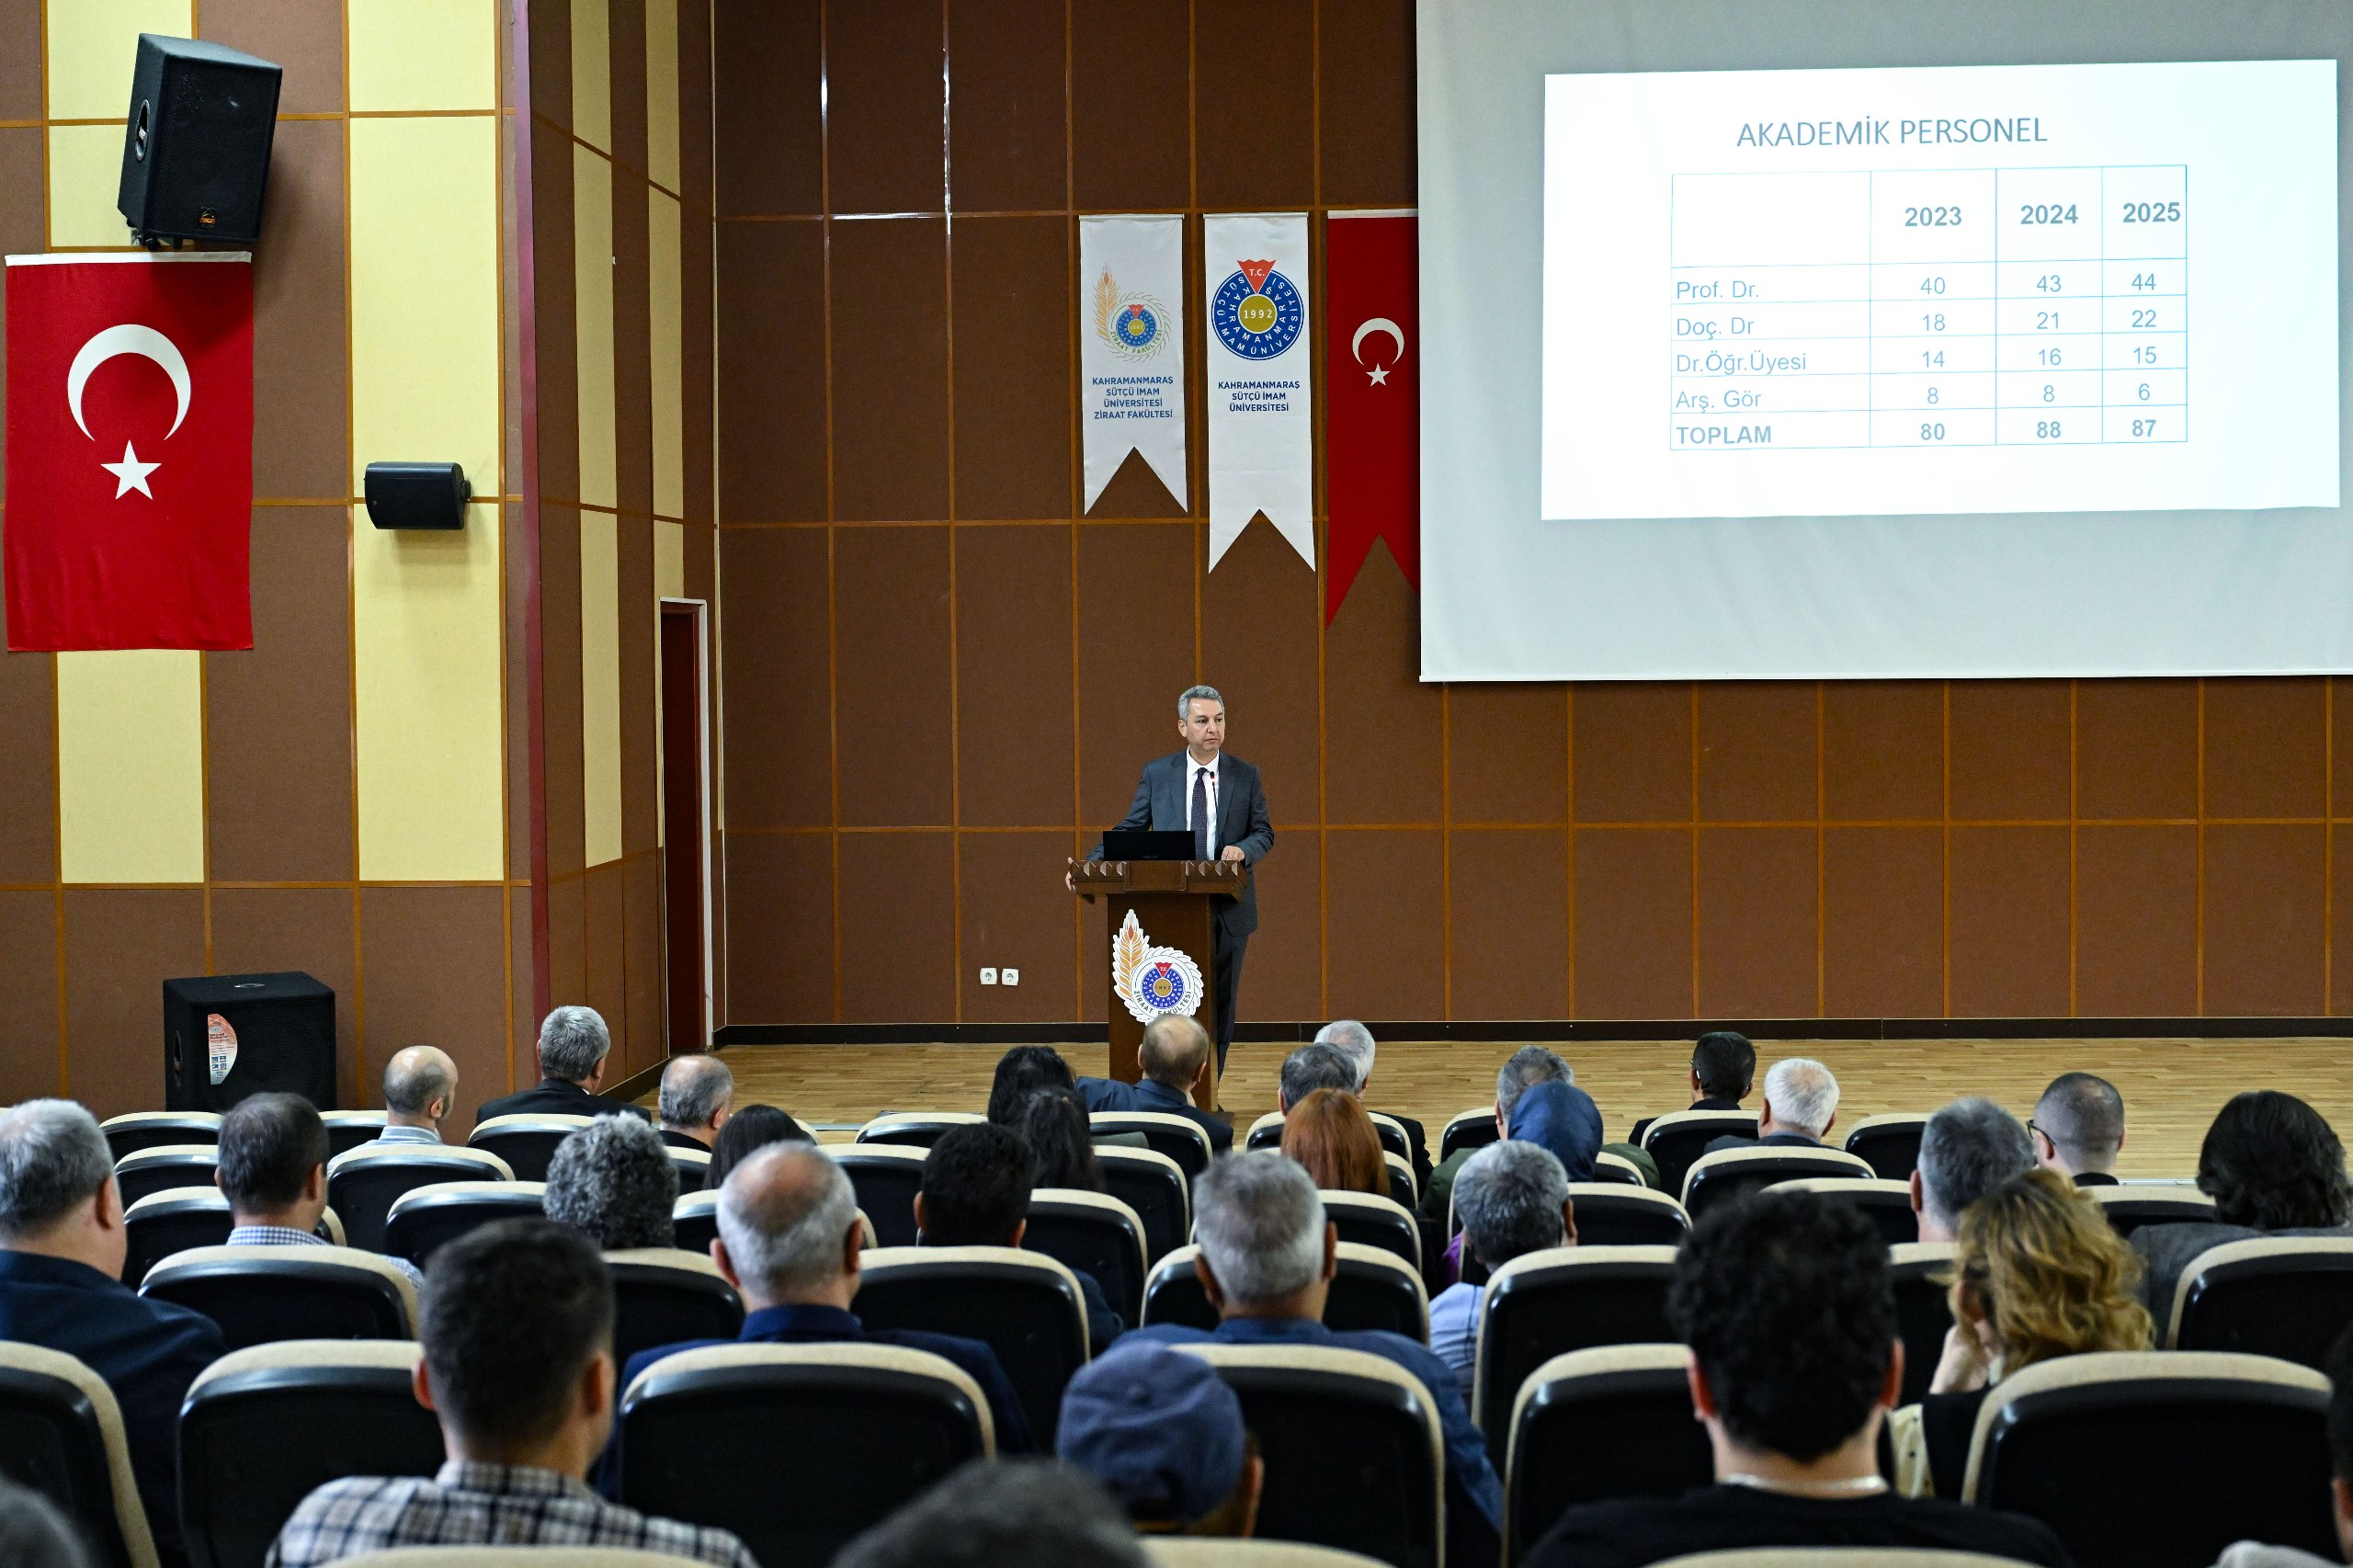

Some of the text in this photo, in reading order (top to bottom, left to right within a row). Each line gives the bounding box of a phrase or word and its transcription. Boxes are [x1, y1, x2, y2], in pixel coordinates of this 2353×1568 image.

[1736, 115, 2049, 147] AKADEMİK PERSONEL
[1904, 201, 2181, 227] 2023 2024 2025
[1248, 268, 1265, 277] T.C.
[1677, 272, 2156, 300] Prof. Dr. 40 43 44
[1244, 309, 1272, 319] 1992
[1677, 309, 2157, 340] Doç. Dr 18 21 22
[1677, 346, 2157, 375] Dr.Öğr.Üyesi 14 16 15
[1092, 376, 1174, 385] KAHRAMANMARAŞ
[1218, 381, 1301, 390] KAHRAMANMARAŞ
[1106, 386, 1160, 397] SÜTÇÜ İMAM
[1232, 391, 1286, 402] SÜTÇÜ İMAM
[1103, 397, 1163, 408] ÜNİVERSİTESİ
[1675, 382, 2151, 414] Arş. Gör 8 8 6
[1229, 402, 1289, 412] ÜNİVERSİTESİ
[1094, 408, 1173, 419] ZİRAAT FAKÜLTESİ
[1676, 418, 2157, 445] TOPLAM 80 88 87
